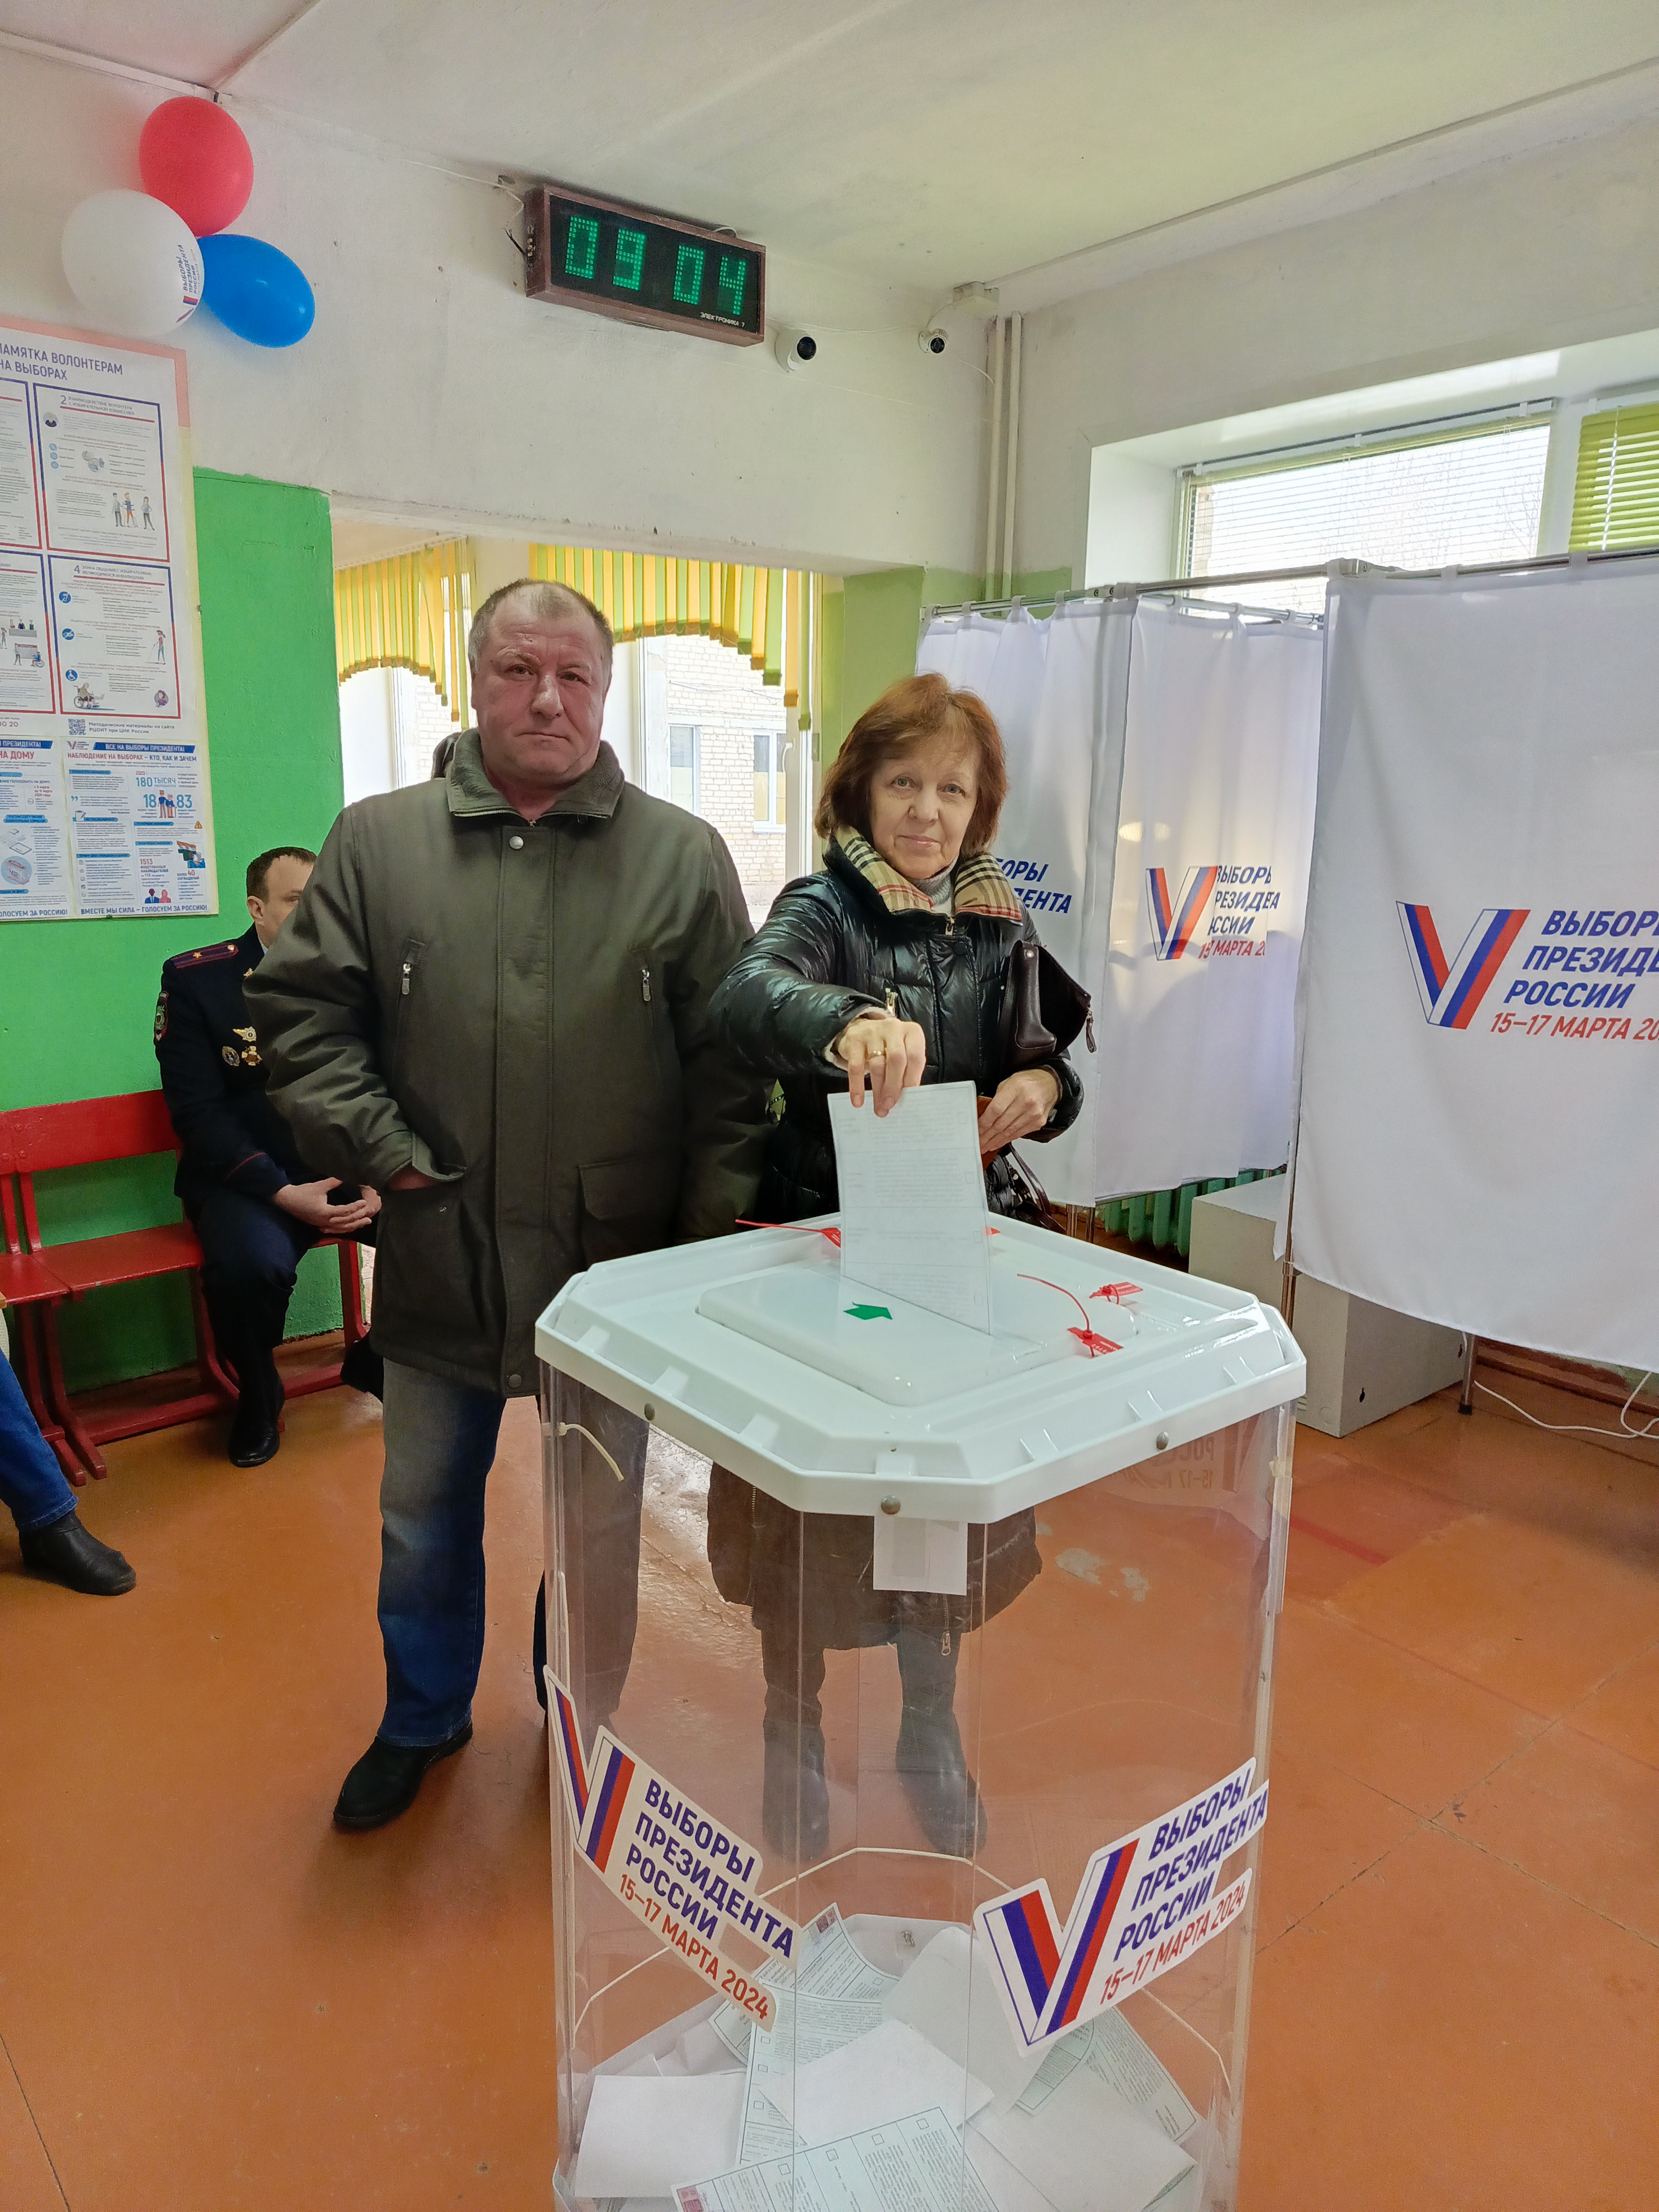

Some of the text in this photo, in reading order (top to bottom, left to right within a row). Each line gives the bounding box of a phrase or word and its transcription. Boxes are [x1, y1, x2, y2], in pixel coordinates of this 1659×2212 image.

[176, 256, 188, 291] ВЫБОРЫ
[700, 312, 739, 326] ЭЛЕКТРОНИКА
[15, 361, 67, 380] ВЫБОРАХ
[51, 352, 123, 375] ВОЛОНТЕРАМ
[60, 395, 66, 404] 2
[74, 565, 81, 574] 4
[10, 750, 35, 760] ДОМУ
[135, 777, 153, 787] 180
[143, 793, 157, 808] 18
[176, 794, 192, 808] 83
[1212, 940, 1254, 956] МАРТА
[1503, 979, 1636, 1009] РОССИИ
[1550, 1015, 1632, 1040] МАРТА
[1148, 1767, 1252, 1862] ВЫБОРЫ
[644, 1778, 756, 1883] ВЫБОРЫ
[1131, 1787, 1268, 1912] ПРЕЗИДЕНТА
[626, 1842, 719, 1941] РОССИИ
[635, 1811, 794, 1959] ПРЕЗИДЕНТА
[1113, 1870, 1216, 1963] РОССИИ
[1152, 1914, 1210, 1973] МАРТА
[1209, 1879, 1246, 1936] 2024
[662, 1913, 720, 1982] МАРТА
[721, 1967, 769, 2021] 2024
